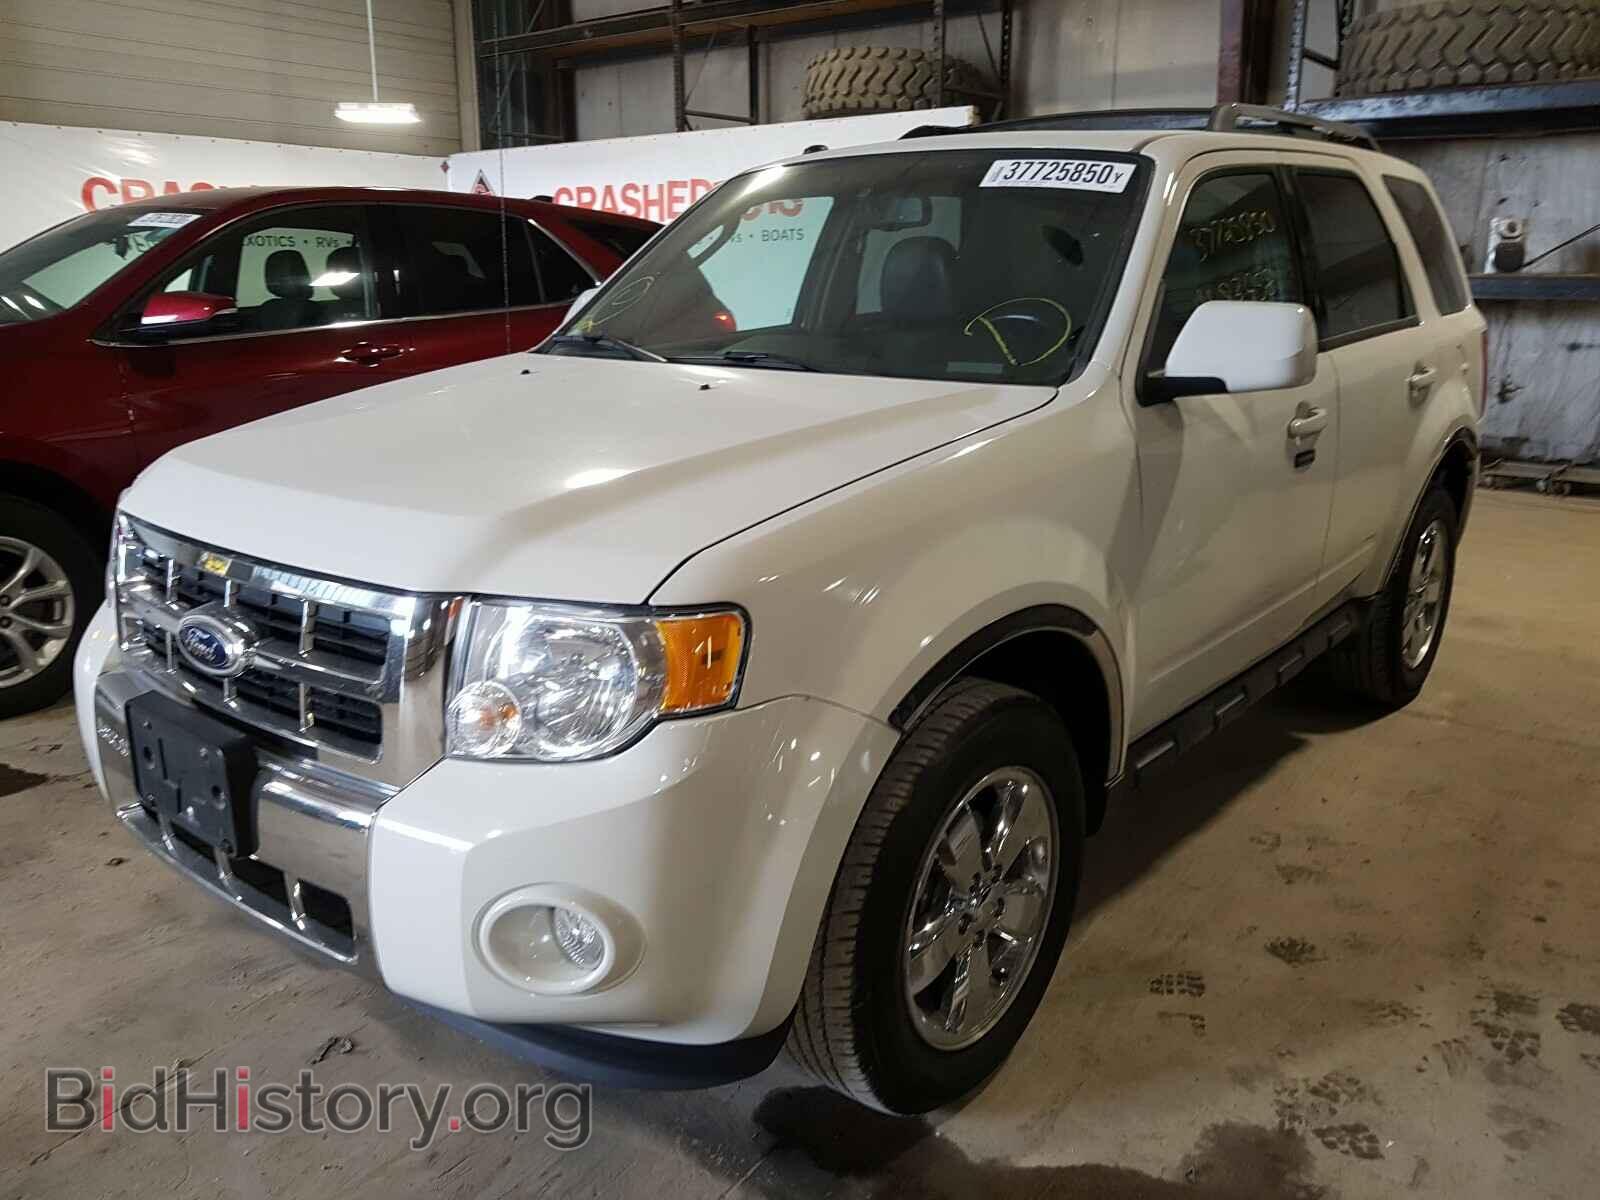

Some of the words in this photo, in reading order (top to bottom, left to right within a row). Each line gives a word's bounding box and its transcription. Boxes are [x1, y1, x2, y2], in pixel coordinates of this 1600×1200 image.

[1004, 161, 1115, 184] 37725850
[243, 235, 296, 248] XOTICS
[761, 228, 804, 242] BOATS
